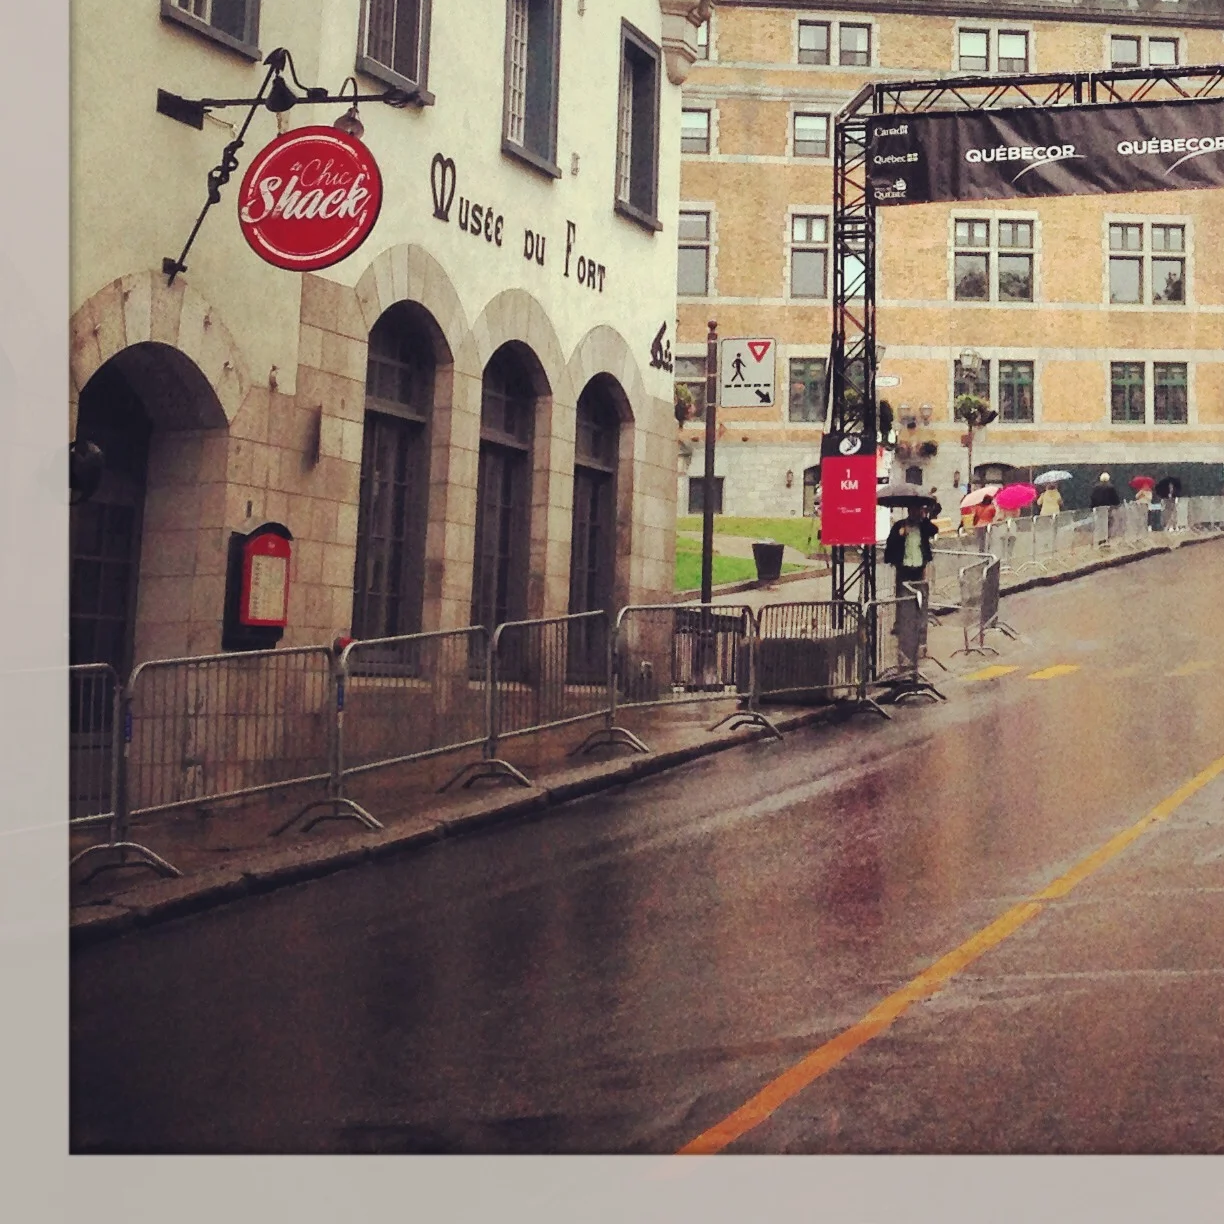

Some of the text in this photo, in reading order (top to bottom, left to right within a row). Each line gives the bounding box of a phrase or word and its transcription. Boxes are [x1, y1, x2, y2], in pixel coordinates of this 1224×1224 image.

[965, 145, 1076, 163] QUÉBECOR
[301, 158, 352, 187] Chic
[241, 173, 371, 223] Shack
[846, 468, 852, 479] 1
[840, 479, 858, 490] KM
